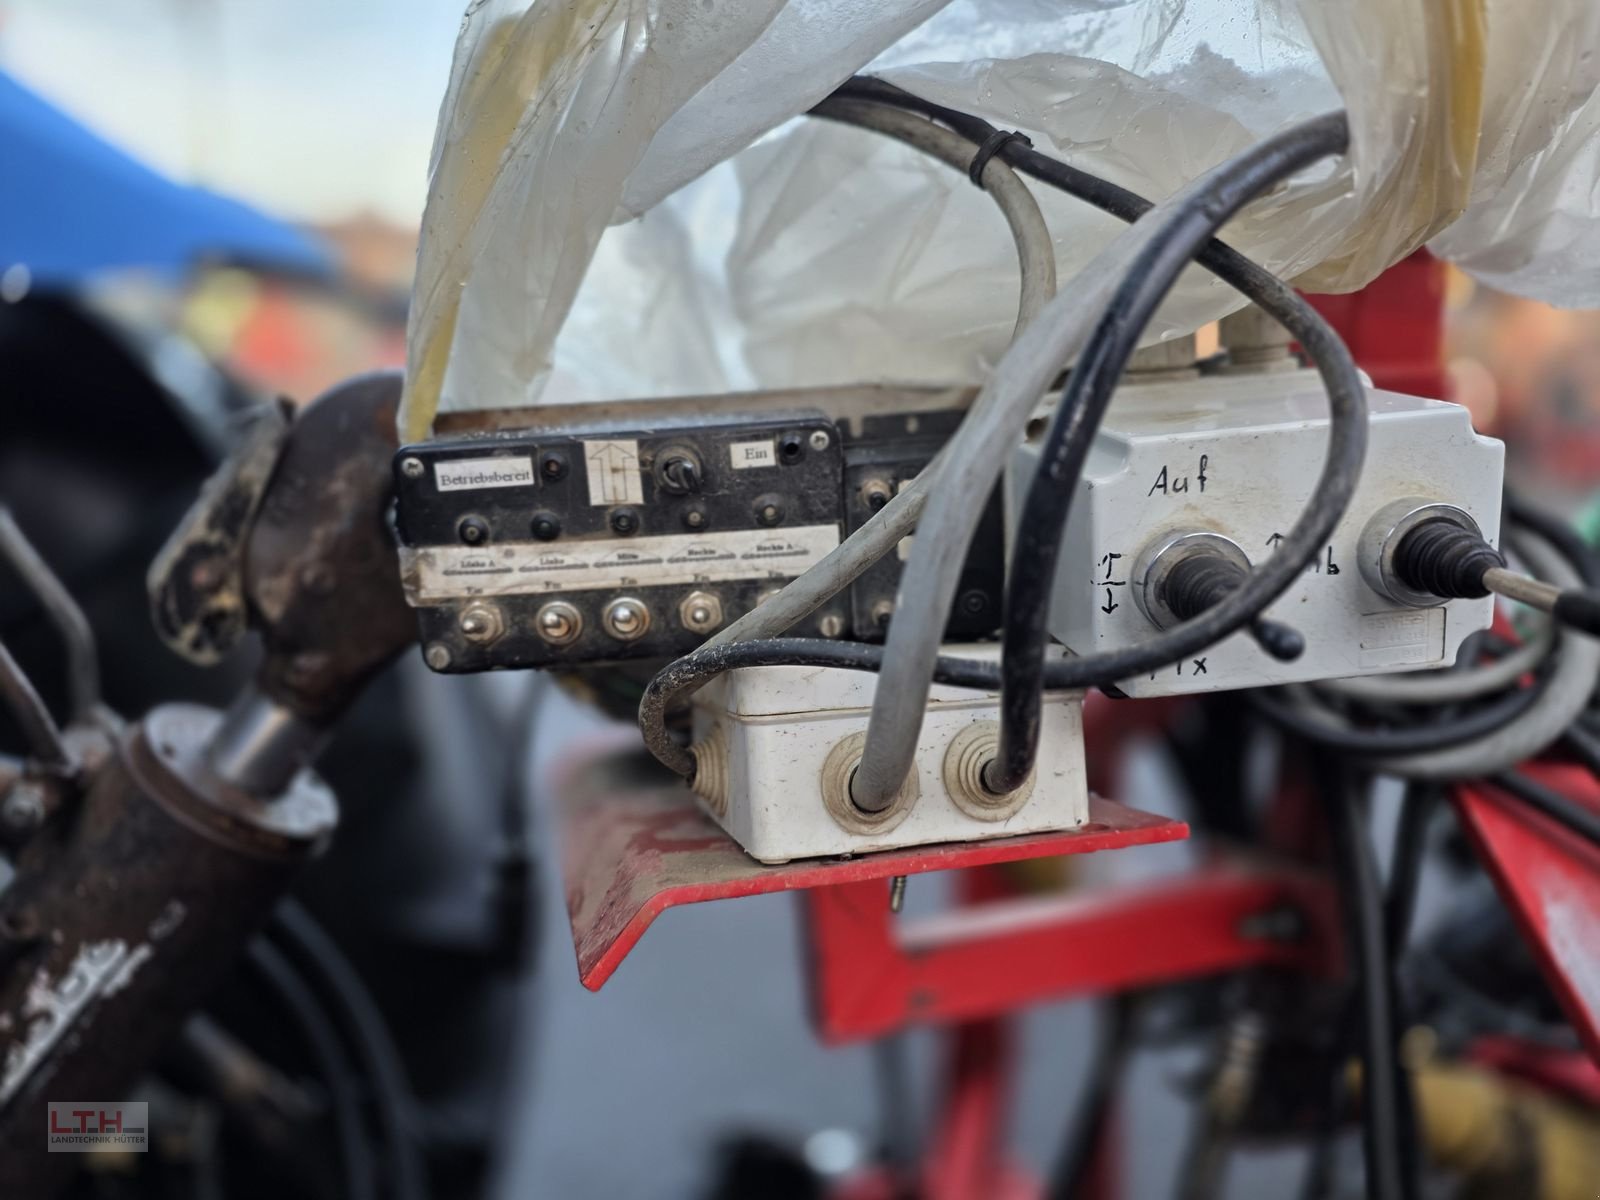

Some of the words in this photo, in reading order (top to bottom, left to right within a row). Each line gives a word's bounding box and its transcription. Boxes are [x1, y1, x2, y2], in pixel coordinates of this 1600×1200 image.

[744, 448, 768, 461] Ein
[440, 471, 530, 487] Betriebsbereit
[1148, 454, 1208, 496] Auf
